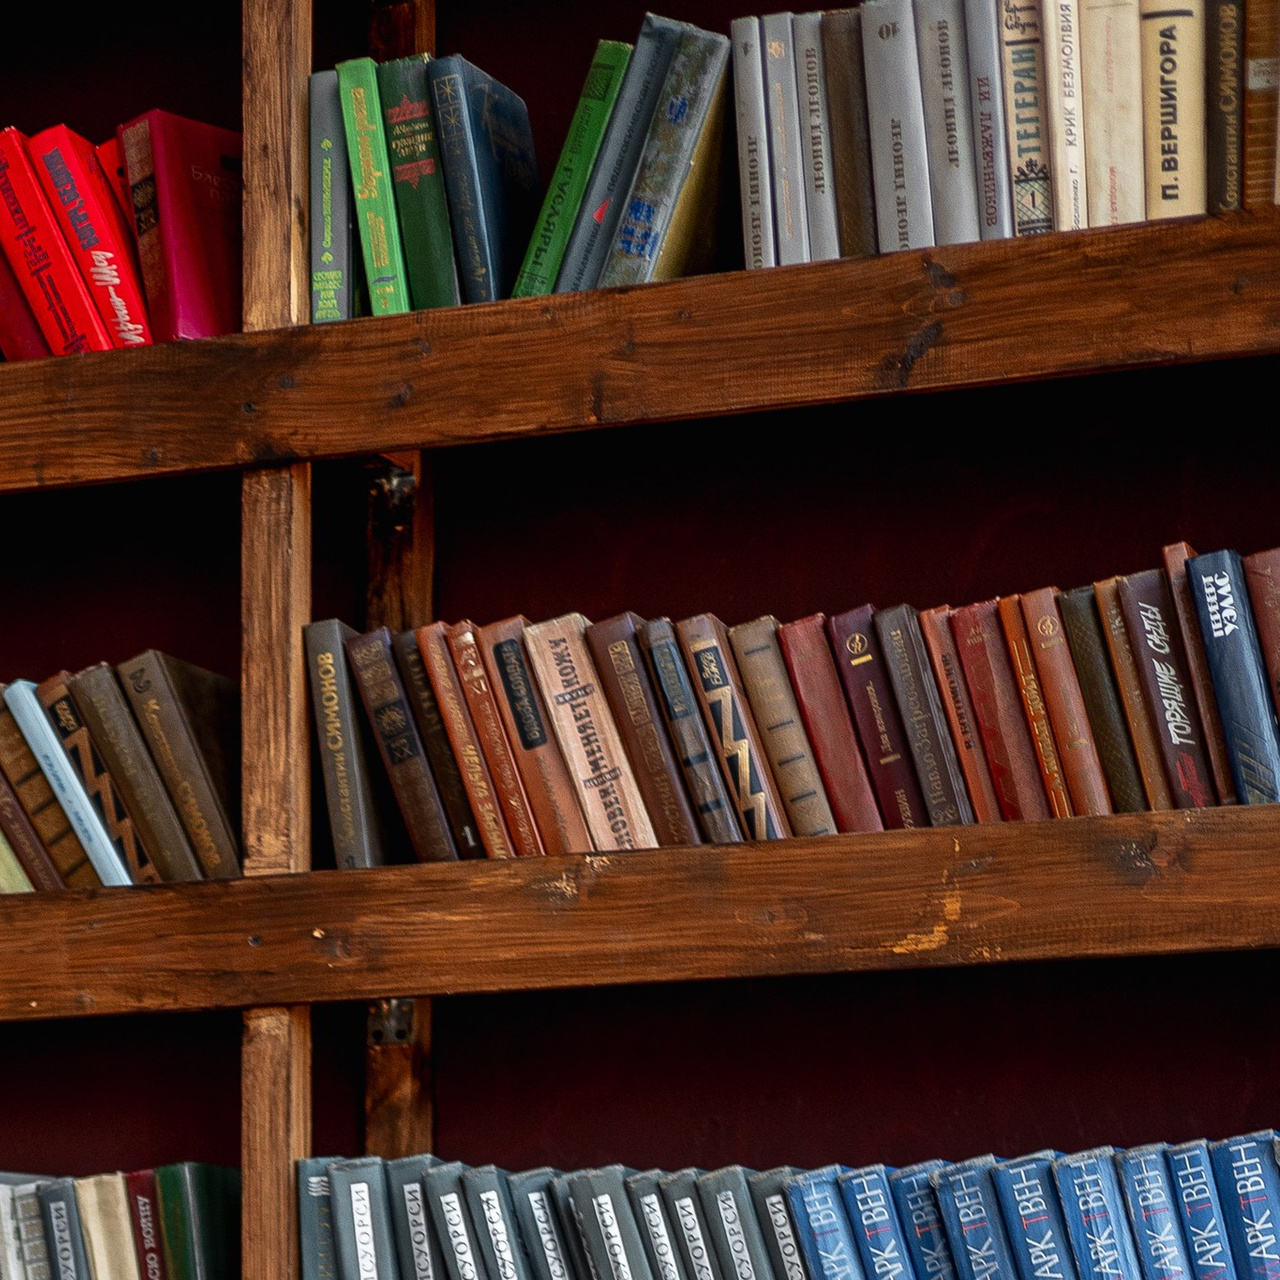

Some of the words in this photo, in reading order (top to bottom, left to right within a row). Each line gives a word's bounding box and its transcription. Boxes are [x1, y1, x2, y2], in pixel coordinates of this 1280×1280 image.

[805, 48, 820, 118] ЛЕОНОВ
[937, 20, 954, 91] ЛЕОНОВ
[1060, 4, 1075, 97] БЕЗМОЛВИЯ
[1219, 4, 1238, 112] СИМОНОВ
[946, 96, 960, 167] ЛЕОНИД
[1011, 48, 1041, 158] ТЕГЕРАН
[1063, 107, 1077, 147] КРИК
[1159, 25, 1178, 171] ВЕРШИГОРА
[747, 135, 761, 205] ЛЕОНИД
[810, 124, 825, 194] ЛЕОНИД
[891, 119, 906, 190] ЛЕОНИД
[1161, 178, 1179, 200] П.
[751, 212, 763, 270] ЛЕОНО
[897, 195, 909, 251] ЛЕОНО
[1138, 602, 1171, 655] САДЫ
[1202, 574, 1224, 638] ГЕРБЕРТ
[1214, 571, 1239, 637] УЭЛЛС
[548, 637, 580, 685] КОЖУ
[1021, 671, 1045, 716] ДОЙЛ
[317, 652, 342, 750] СИМОНОВ
[1152, 657, 1195, 745] ГОРЯЩИЕ
[571, 701, 608, 772] МЕНЯЕТ
[1033, 720, 1057, 772] КОНАН
[851, 1172, 892, 1241] ТВЕН
[902, 1175, 942, 1239] ТВЕН
[948, 1169, 989, 1236] ТВЕН
[1009, 1162, 1050, 1231] ТВЕН
[1069, 1157, 1110, 1227] ТВЕН
[1128, 1153, 1170, 1221] ТВЕН
[1173, 1148, 1213, 1217] ТВЕН
[1228, 1141, 1268, 1211] ТВЕН
[136, 1195, 156, 1248] ВОЙНУ
[803, 1179, 839, 1243] ТВЕН
